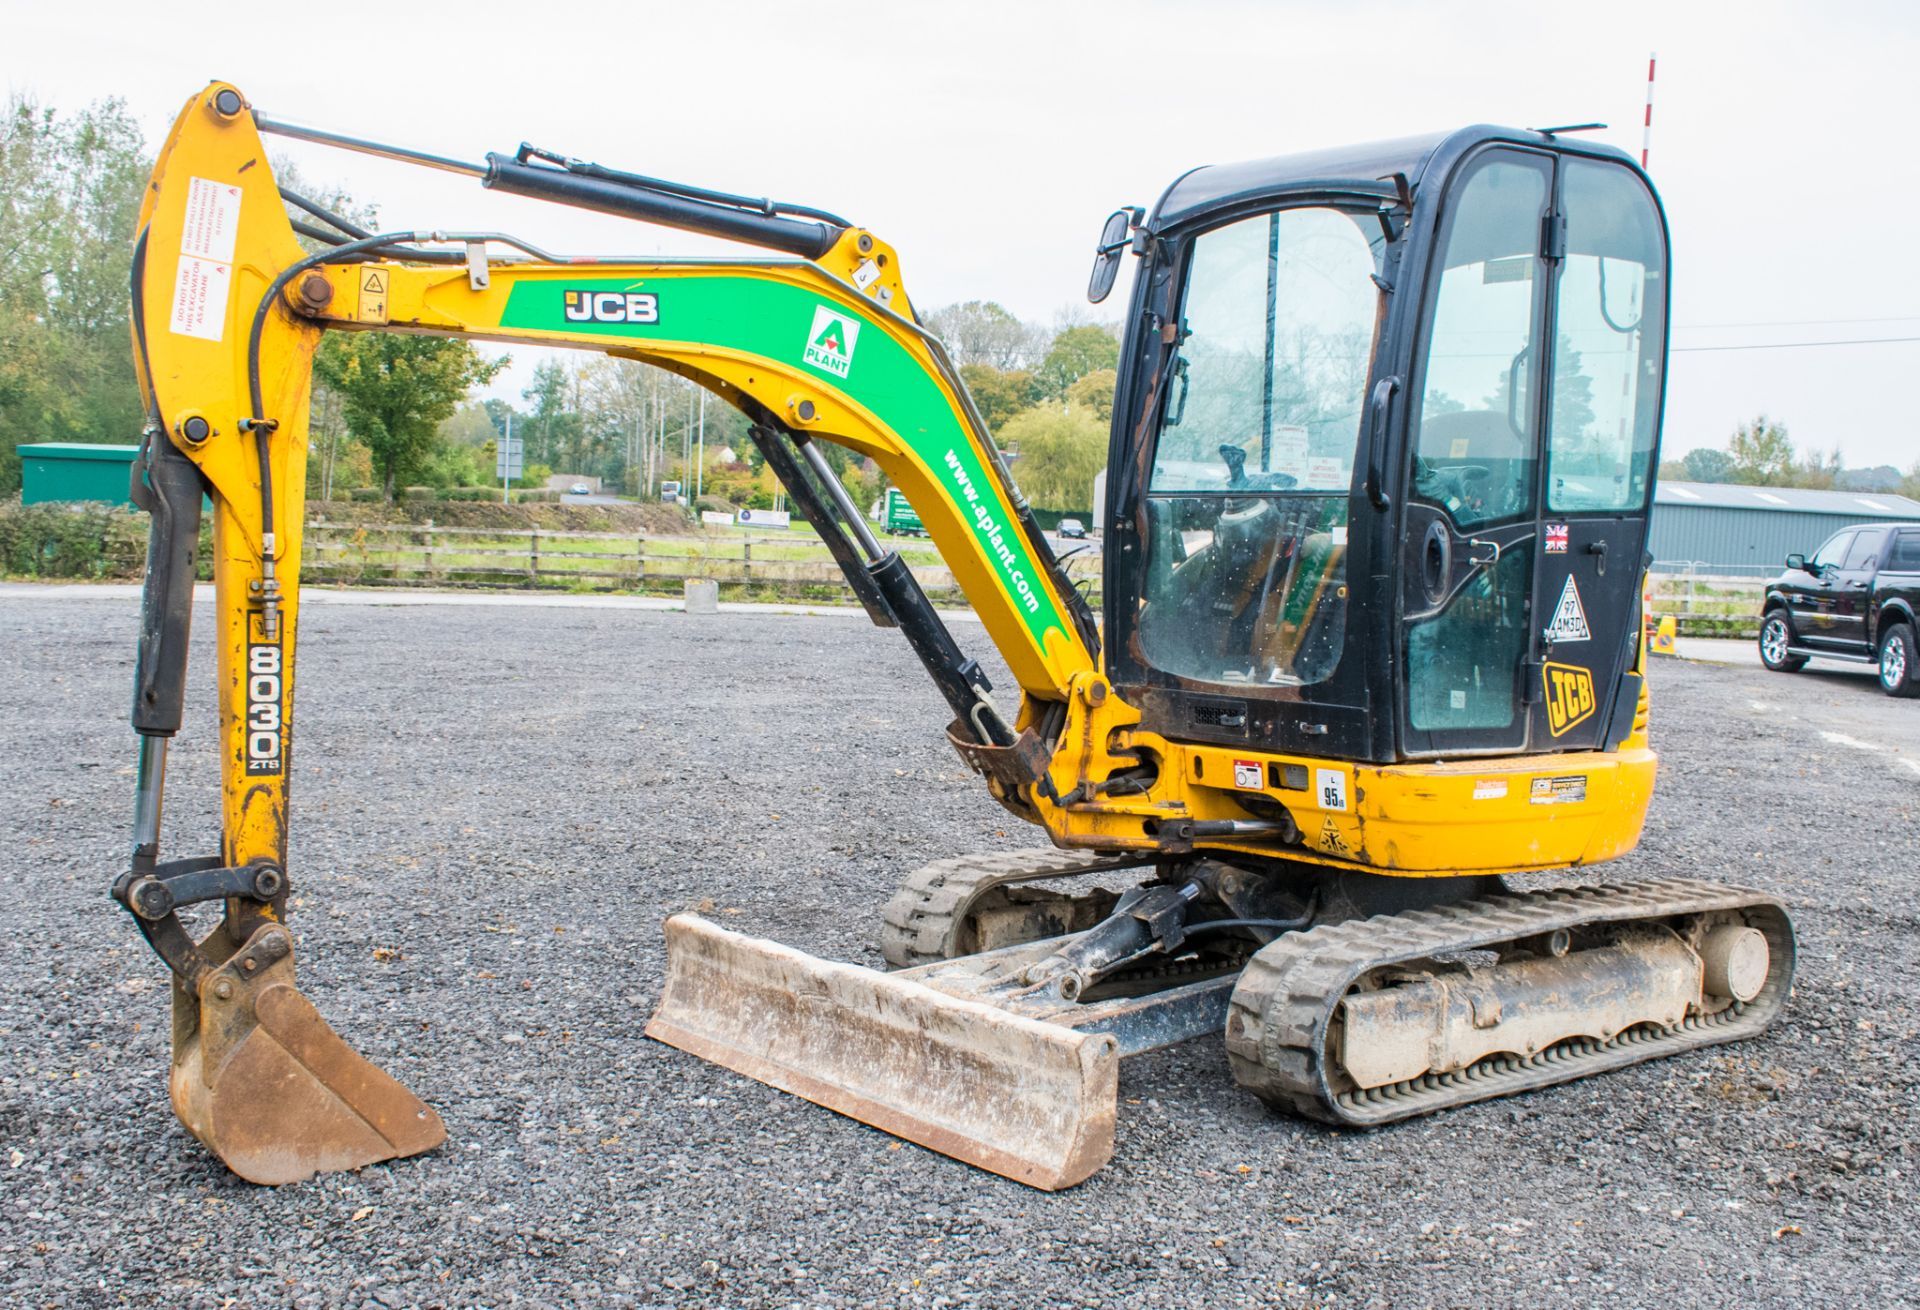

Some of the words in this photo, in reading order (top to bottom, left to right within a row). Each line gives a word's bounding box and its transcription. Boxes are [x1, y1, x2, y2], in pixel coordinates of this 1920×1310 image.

[177, 307, 185, 322] DO
[182, 269, 190, 285] USE
[188, 261, 200, 312] EXCAVATOR
[199, 274, 208, 303] CRANE
[566, 292, 658, 322] JCB
[185, 313, 194, 332] THIS
[814, 318, 847, 357] A
[806, 347, 848, 373] PLANT
[944, 448, 1040, 614] www.aplant.com
[1564, 600, 1576, 616] 97
[249, 646, 280, 759] 8030
[1551, 669, 1592, 728] JCB
[249, 760, 280, 770] ZTS
[1324, 787, 1338, 807] 95
